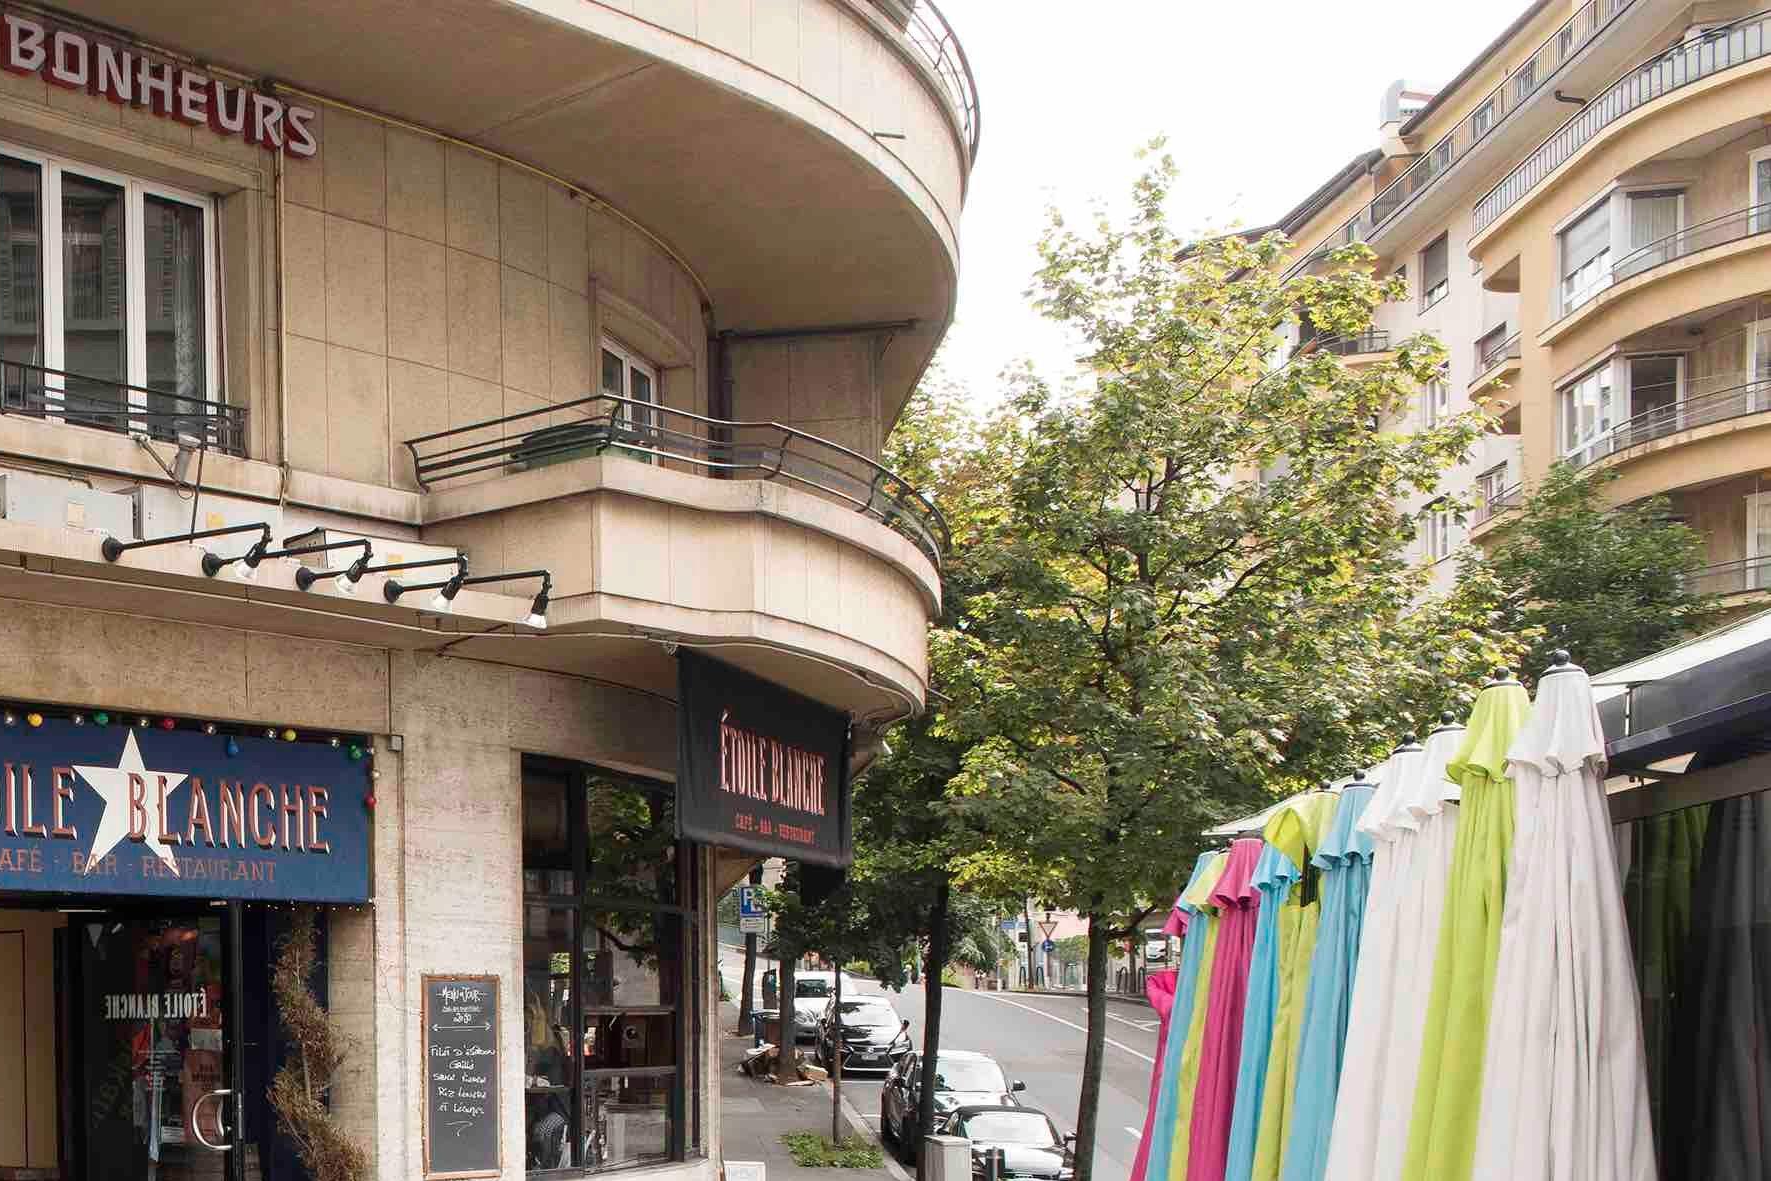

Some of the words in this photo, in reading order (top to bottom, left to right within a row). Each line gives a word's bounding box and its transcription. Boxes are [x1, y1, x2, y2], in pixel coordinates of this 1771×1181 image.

[3, 14, 317, 156] BONHEURS
[719, 710, 768, 802] ÉTOILE
[771, 739, 826, 816] BLANCHE
[127, 772, 331, 855] BLANCHE
[71, 851, 118, 876] BAR
[141, 855, 277, 881] RESTAURANT
